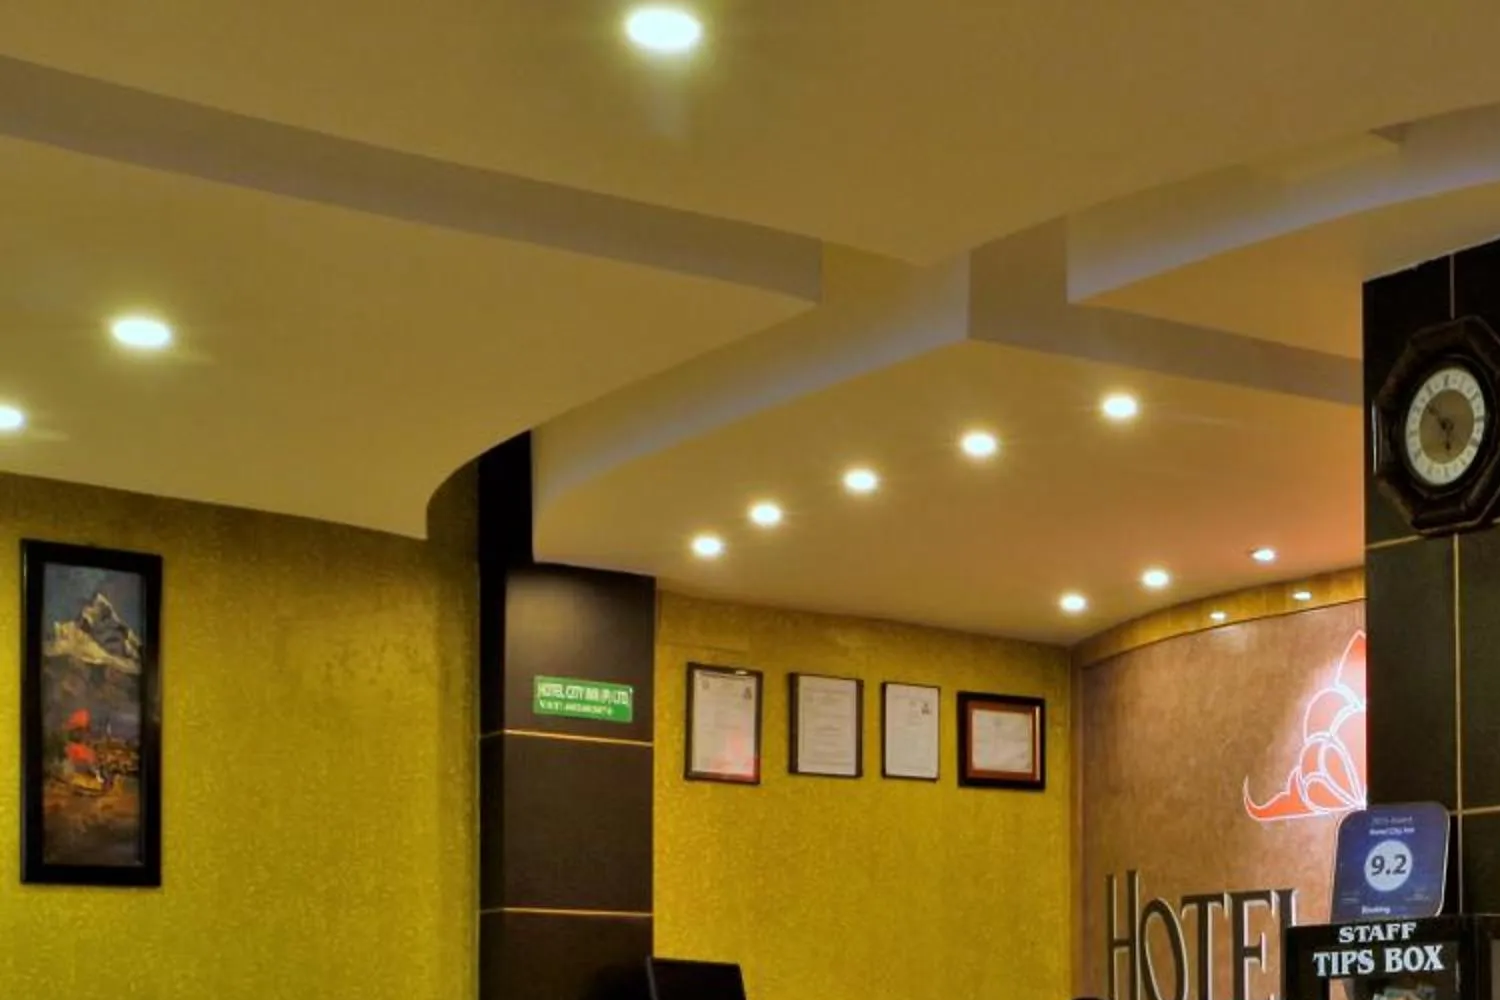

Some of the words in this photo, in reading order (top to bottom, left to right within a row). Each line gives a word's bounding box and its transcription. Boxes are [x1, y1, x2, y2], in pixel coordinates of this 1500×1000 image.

[1370, 854, 1407, 877] 9.2
[1339, 922, 1417, 943] STAFF
[1313, 949, 1375, 977] TIPS
[1385, 944, 1445, 974] BOX
